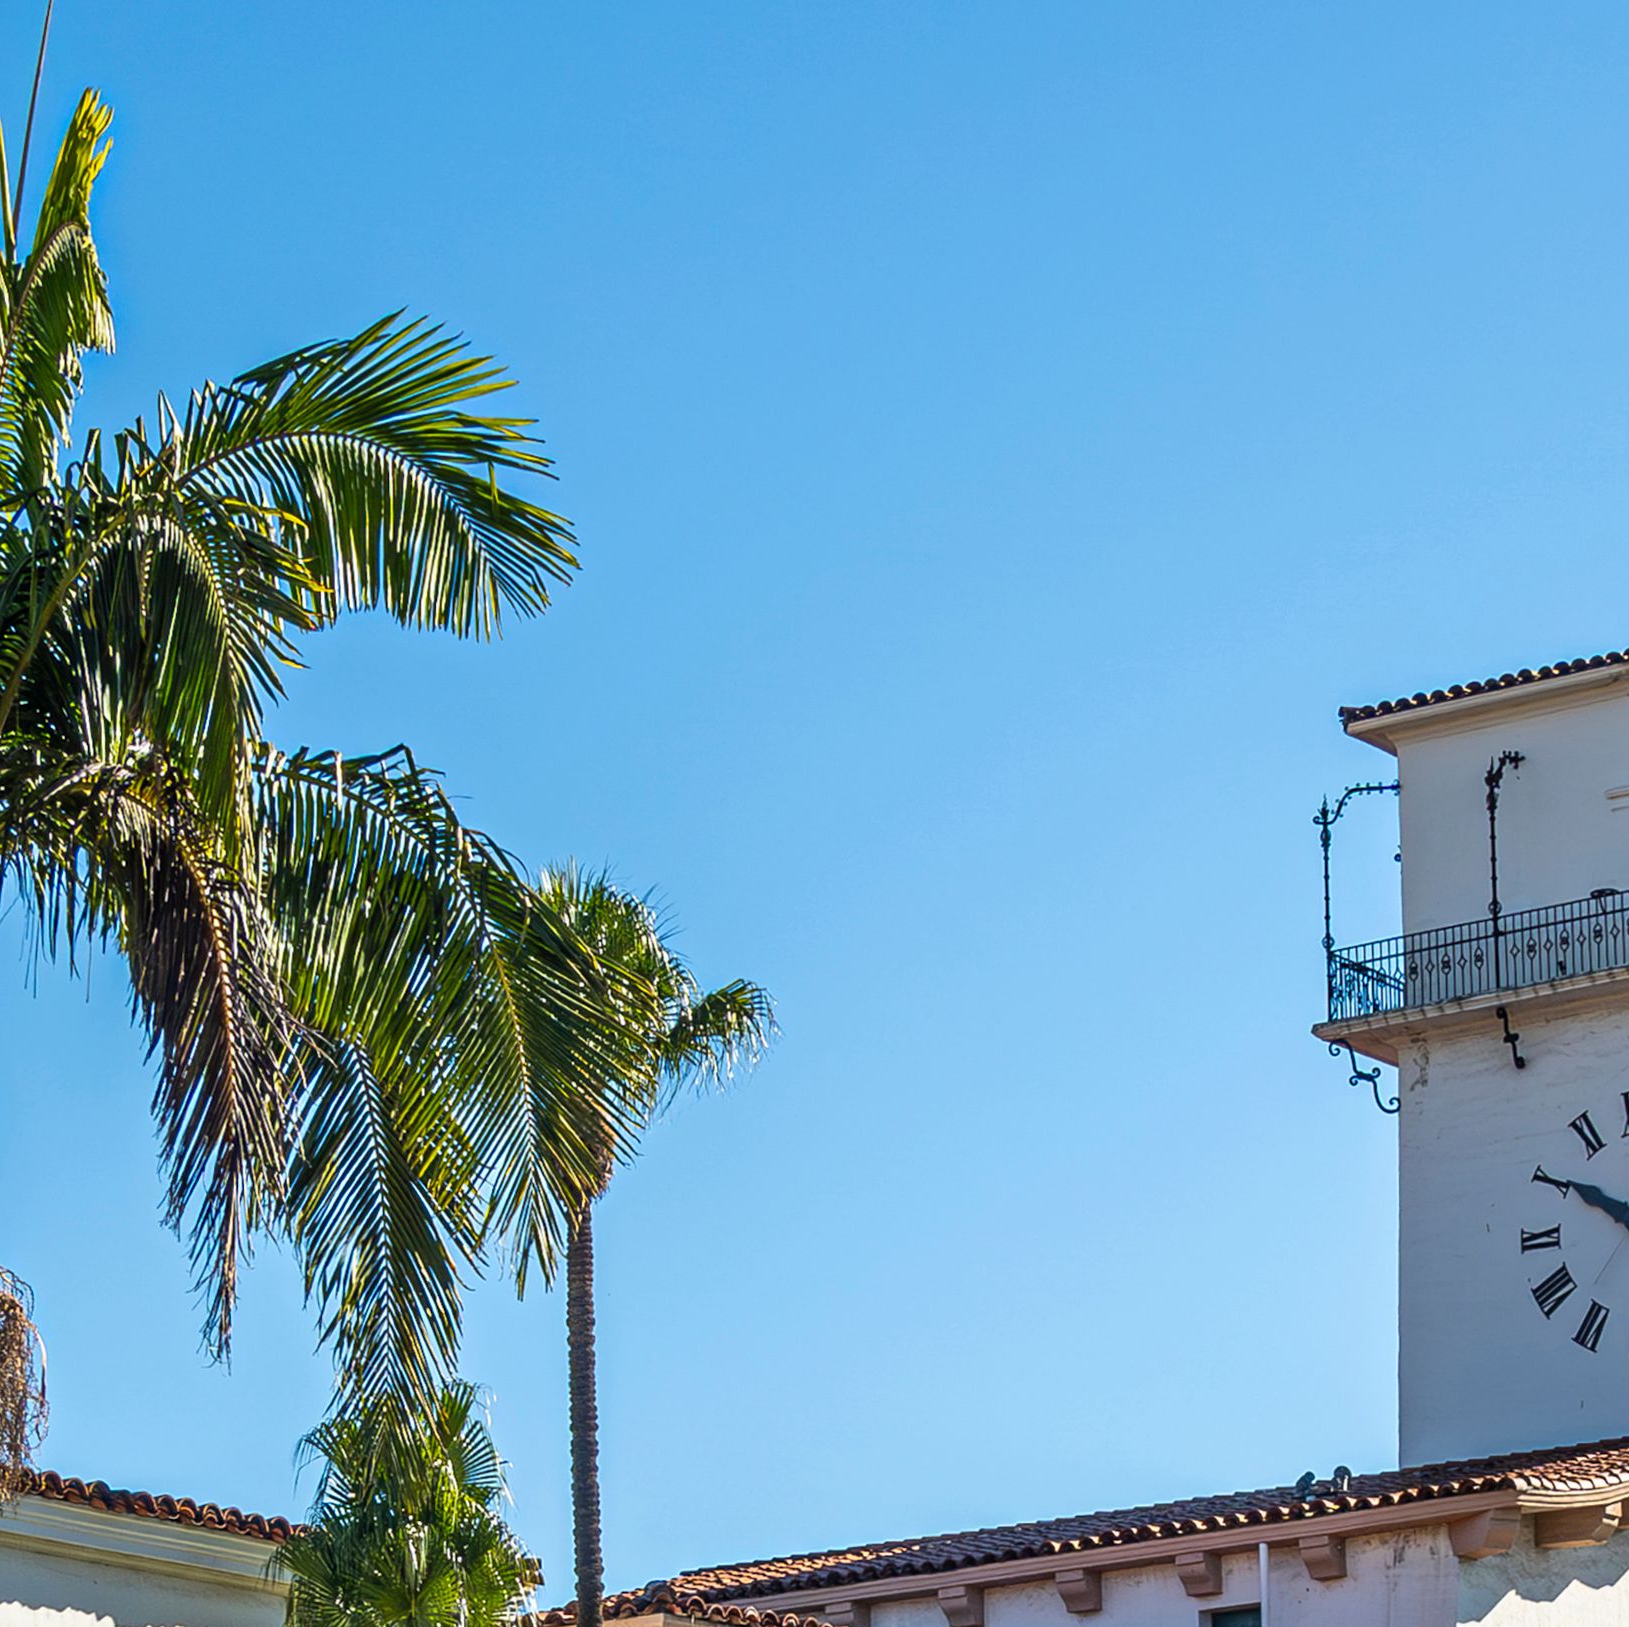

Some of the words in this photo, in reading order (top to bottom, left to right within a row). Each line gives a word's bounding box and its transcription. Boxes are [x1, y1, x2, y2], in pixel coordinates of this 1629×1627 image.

[1568, 1110, 1607, 1161] XI
[1531, 1164, 1570, 1199] X
[1571, 1298, 1610, 1353] VII
